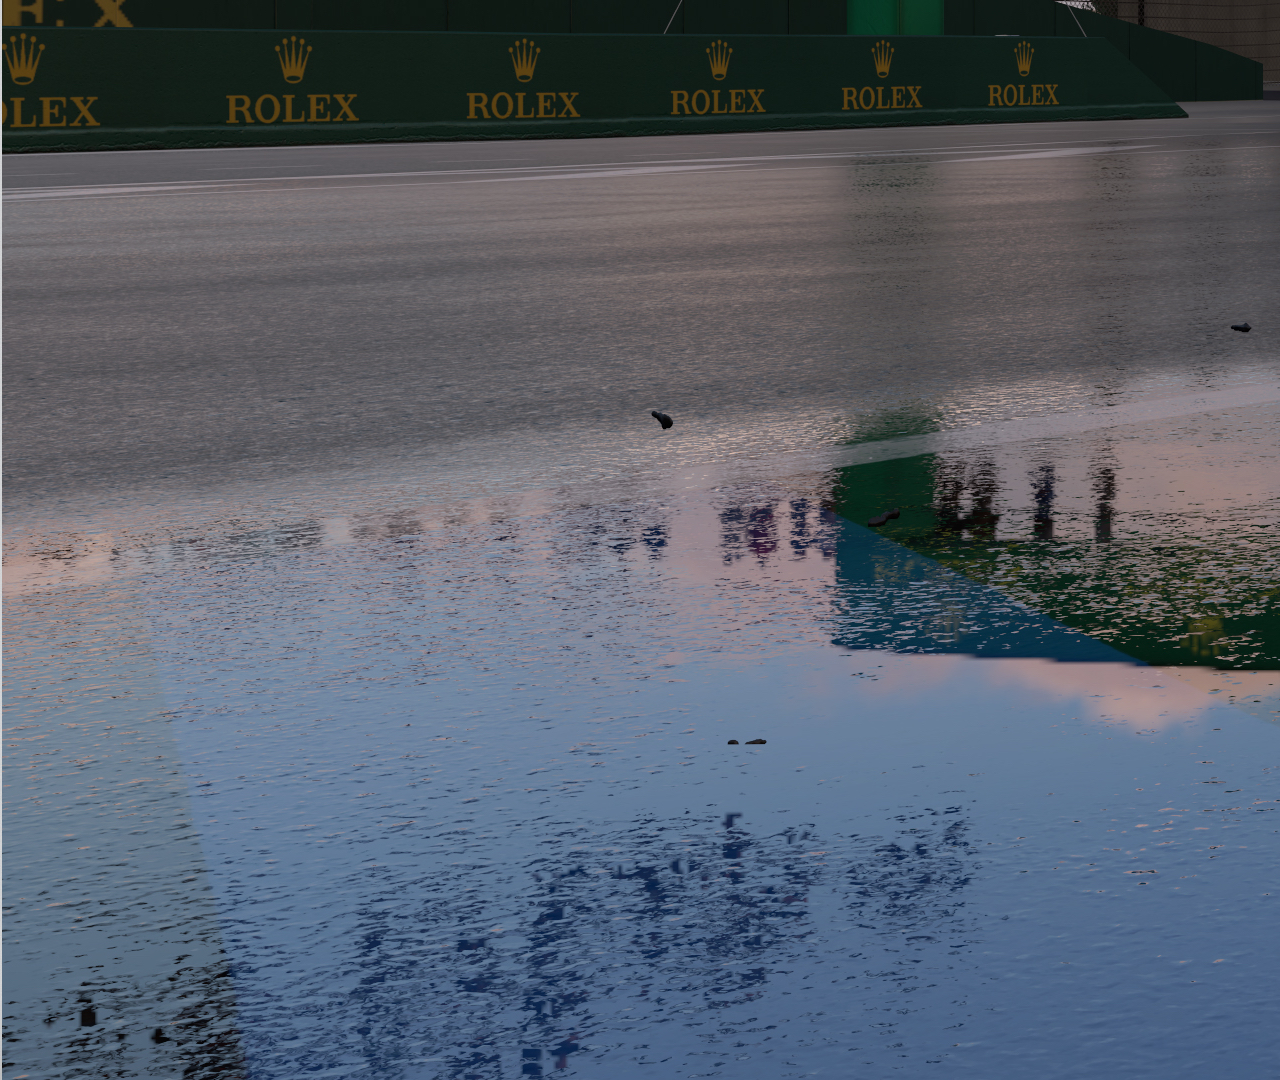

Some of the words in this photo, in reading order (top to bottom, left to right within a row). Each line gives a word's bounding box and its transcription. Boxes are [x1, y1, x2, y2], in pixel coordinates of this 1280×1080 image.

[466, 92, 581, 119] ROLEX
[671, 89, 766, 115] ROLEX
[842, 85, 923, 111] ROLEX
[988, 83, 1060, 107] ROLEX
[2, 96, 101, 128] LEX
[226, 94, 359, 124] ROLEX
